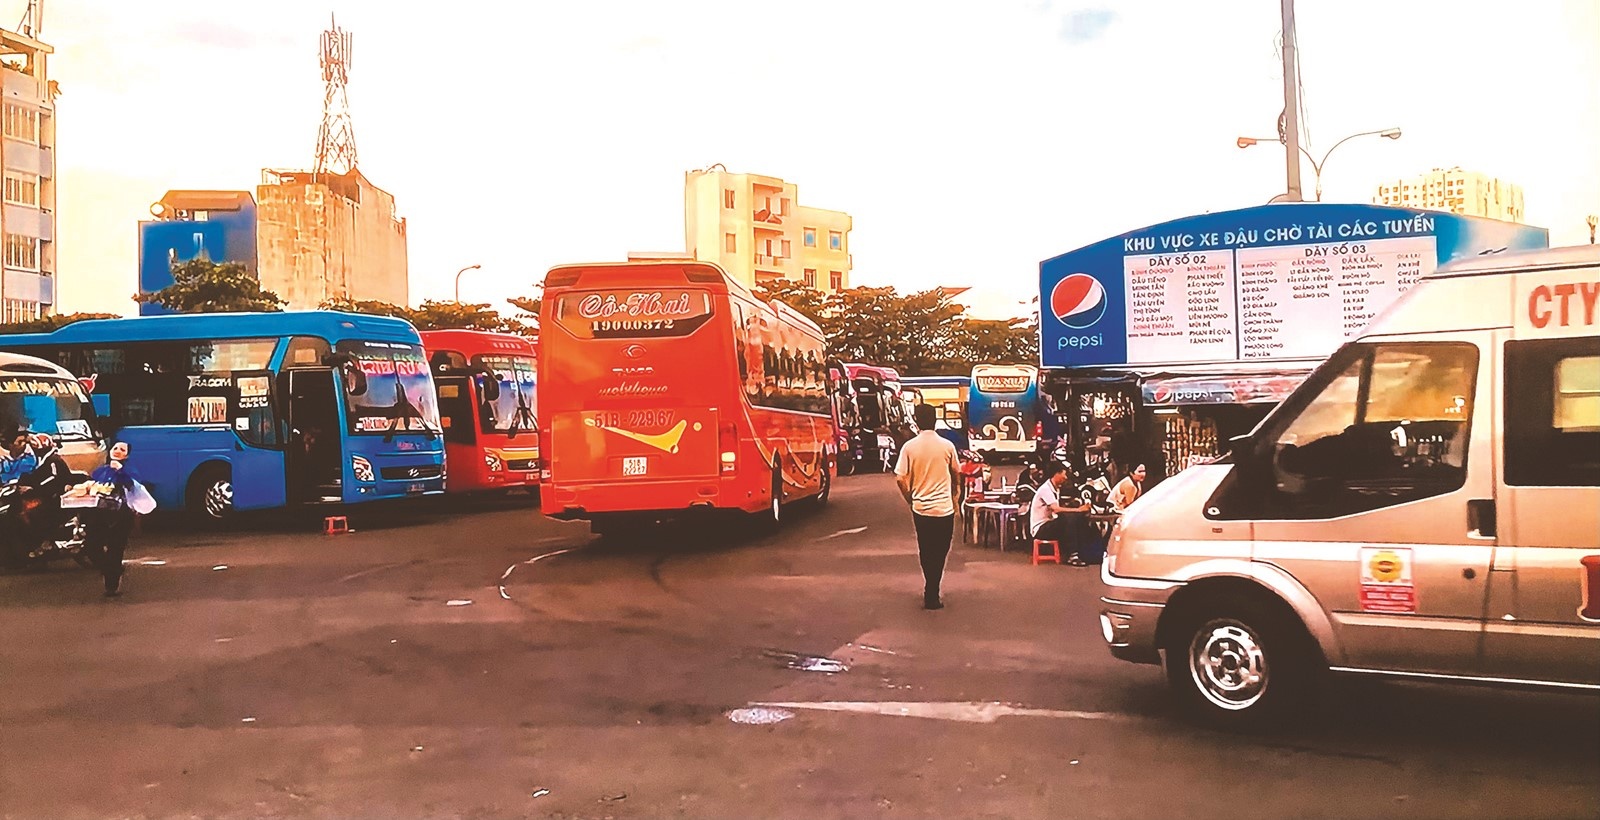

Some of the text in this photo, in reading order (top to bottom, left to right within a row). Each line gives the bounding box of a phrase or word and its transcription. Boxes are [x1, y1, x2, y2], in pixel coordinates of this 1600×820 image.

[1124, 213, 1435, 252] KHU VỰC XE ĐẬU CHỜ TÀI CÁC TUYẾN
[1149, 252, 1206, 267] DÃY SỐ 02
[1305, 242, 1366, 257] DÃY SỐ 03
[578, 293, 619, 319] Cô
[1529, 282, 1600, 329] CTY
[1057, 332, 1103, 351] pepsi
